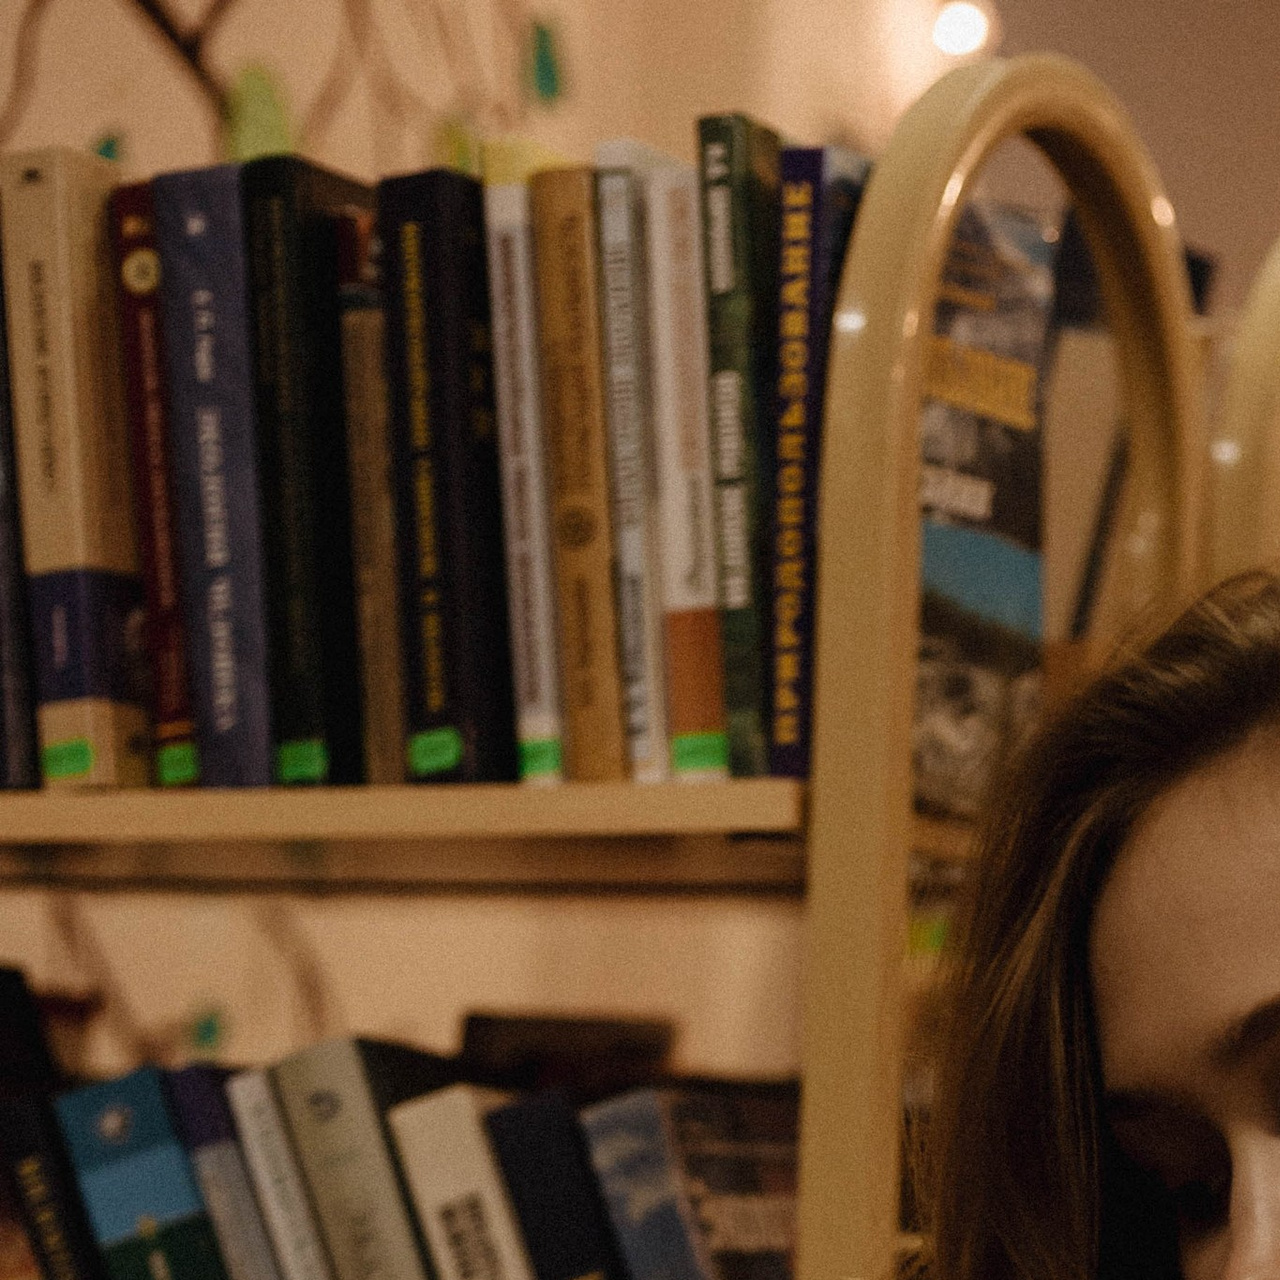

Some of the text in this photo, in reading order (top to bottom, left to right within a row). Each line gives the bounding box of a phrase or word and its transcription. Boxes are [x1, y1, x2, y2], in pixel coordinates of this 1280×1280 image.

[196, 408, 235, 732] ЭКОЛОГИЯ ЧЕЛОВЕКА
[772, 179, 815, 747] ПРИРОДОПОЛЬЗОВАНИЕ
